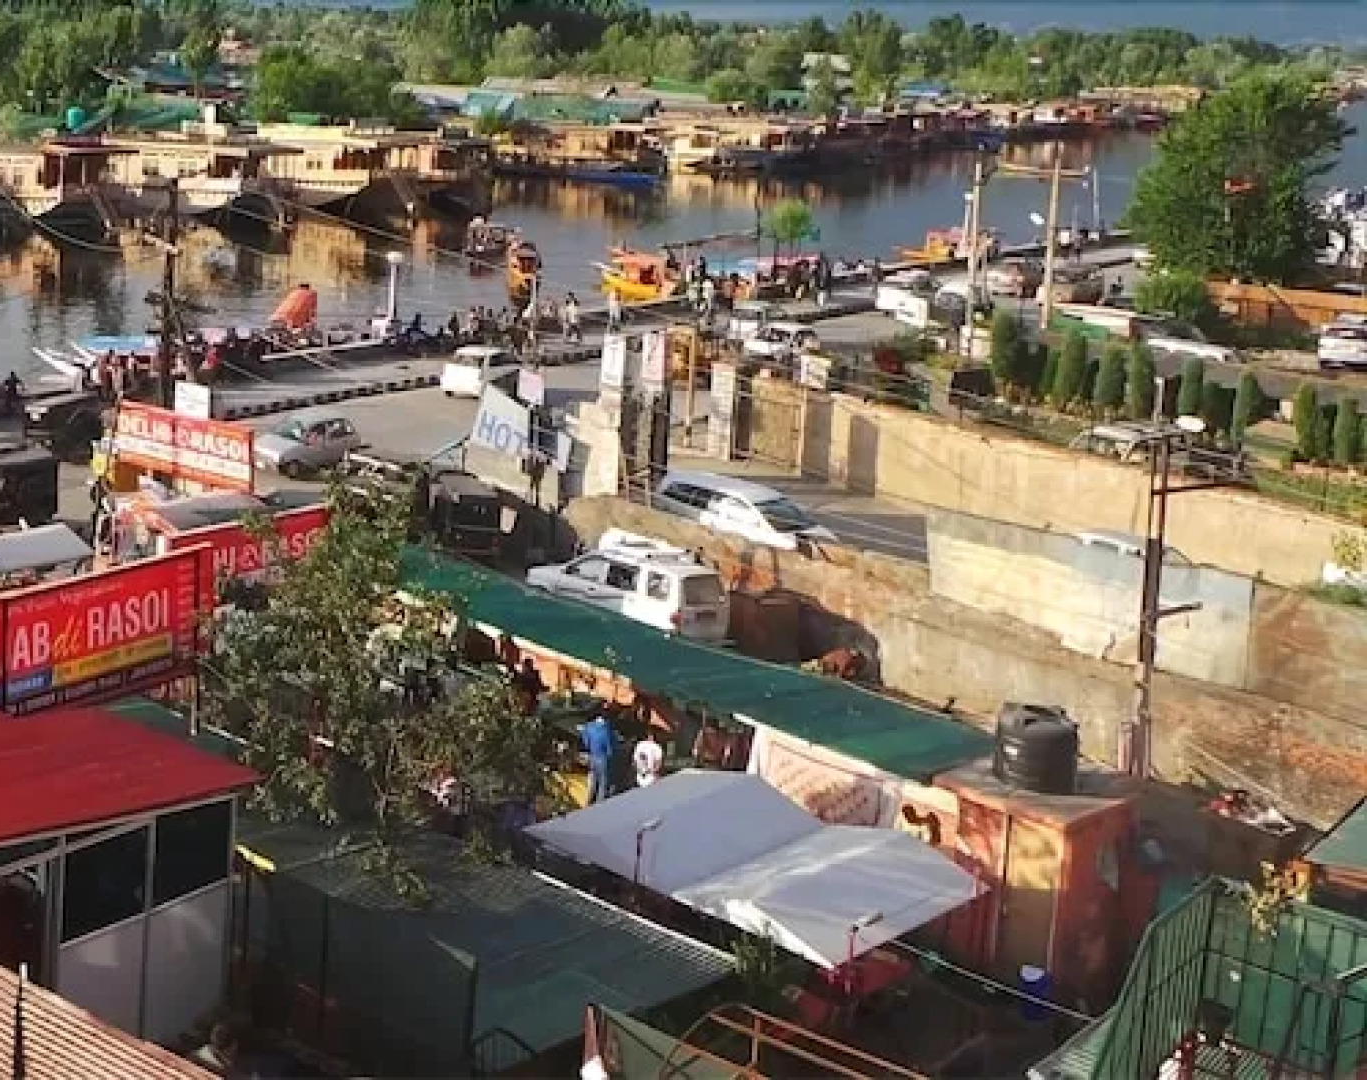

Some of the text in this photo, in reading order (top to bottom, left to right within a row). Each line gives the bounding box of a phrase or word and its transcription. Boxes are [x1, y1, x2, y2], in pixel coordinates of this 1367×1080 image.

[118, 411, 172, 443] DELHI
[479, 409, 529, 453] HOT
[54, 613, 83, 658] di
[86, 587, 169, 649] RASOI
